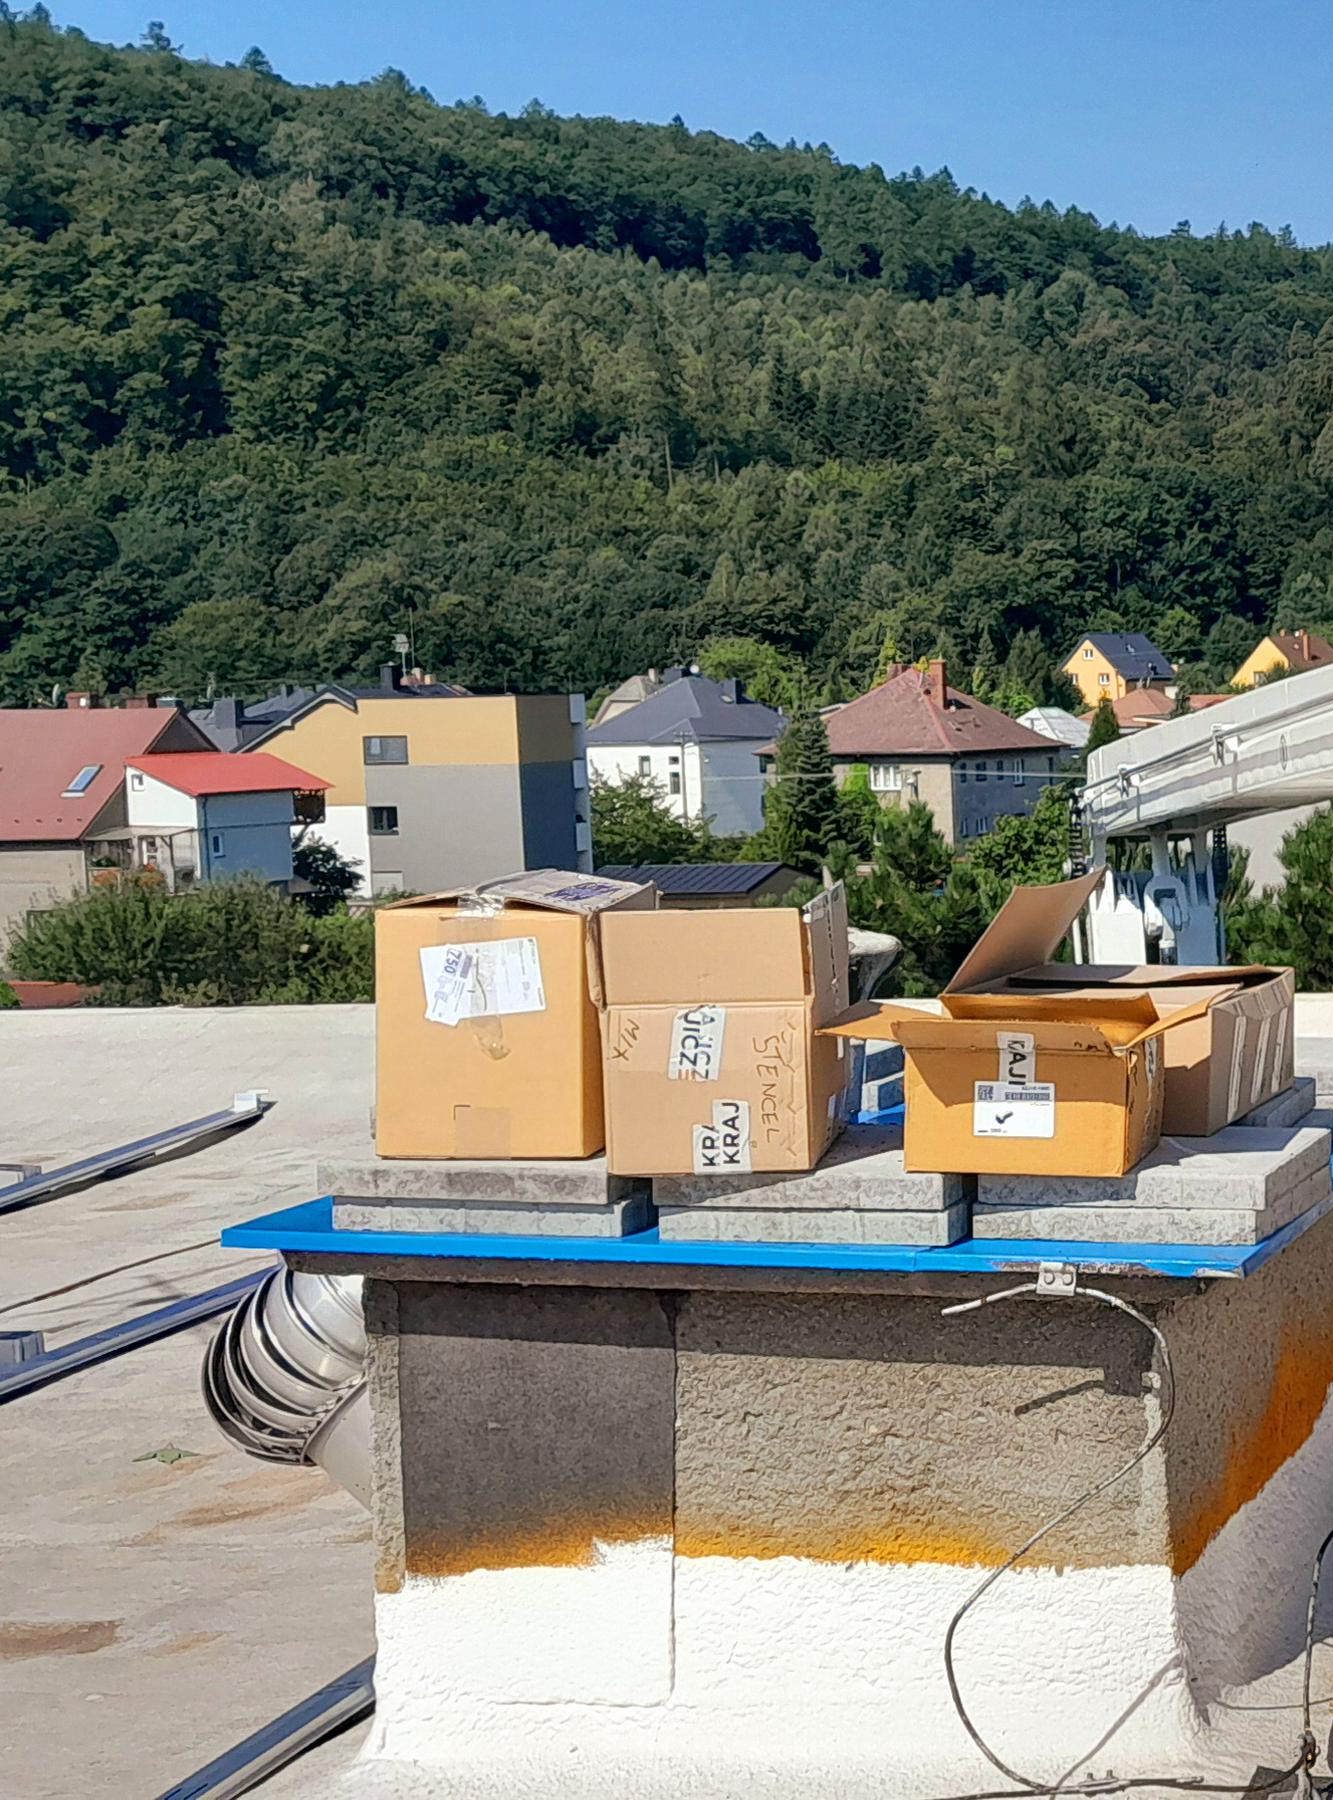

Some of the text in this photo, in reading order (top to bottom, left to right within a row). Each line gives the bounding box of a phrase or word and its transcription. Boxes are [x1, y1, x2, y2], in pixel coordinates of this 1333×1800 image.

[444, 948, 463, 974] 750
[613, 1018, 640, 1061] MIX
[721, 1102, 741, 1165] KRAJ
